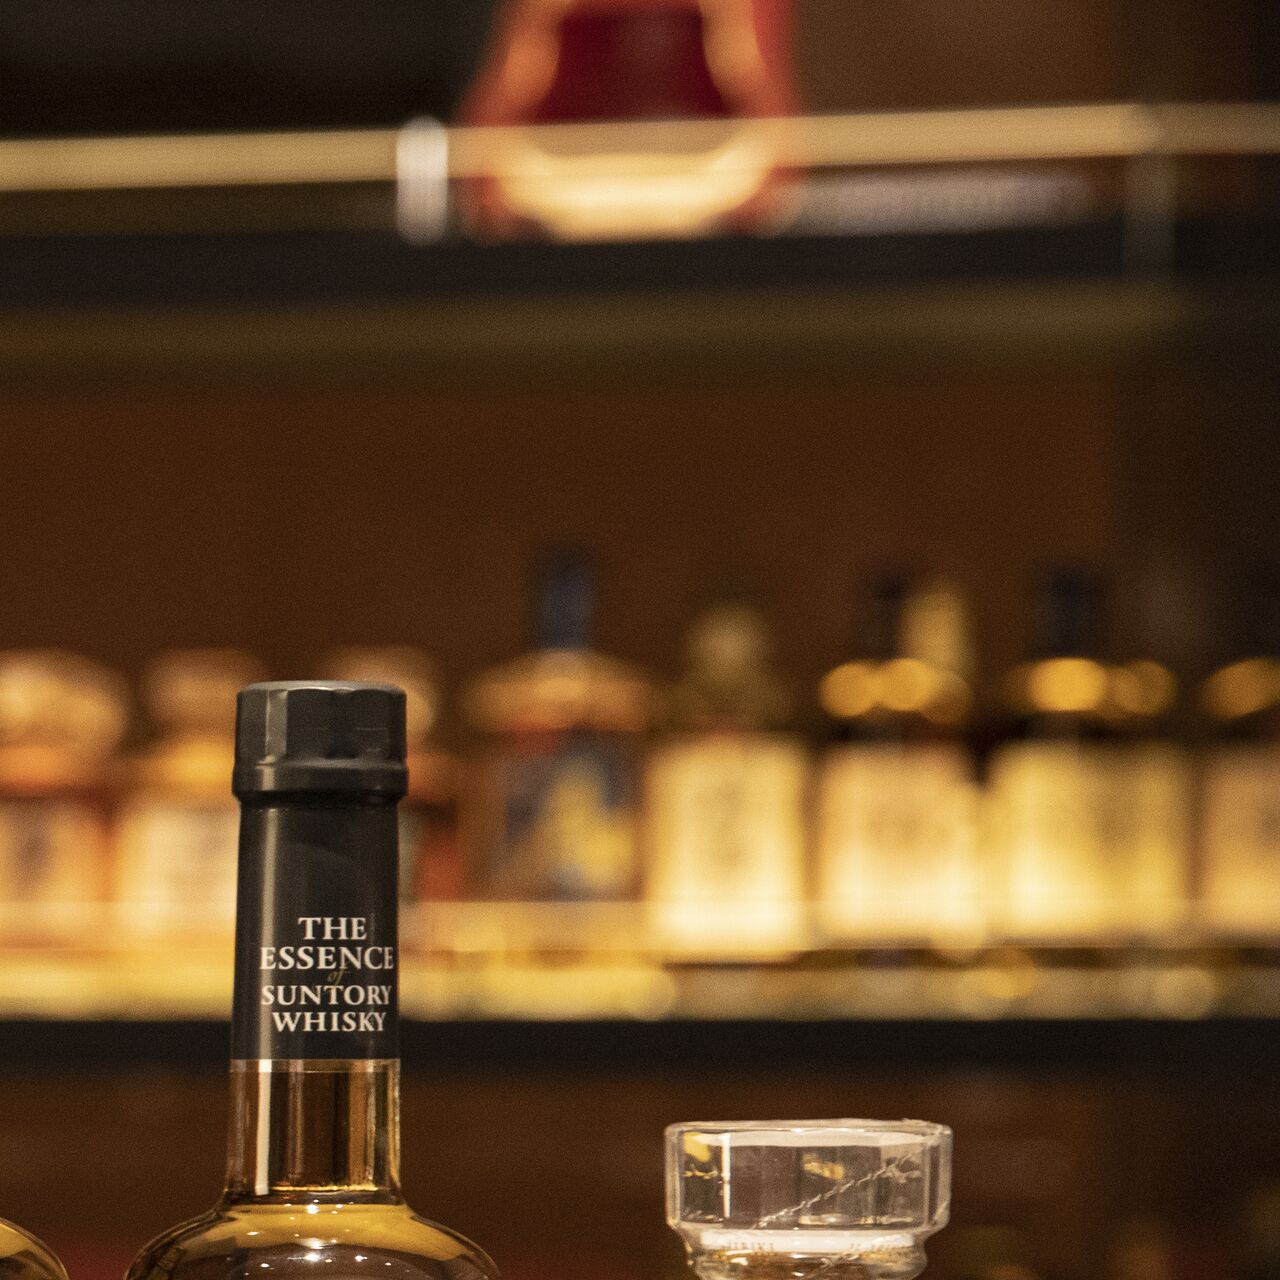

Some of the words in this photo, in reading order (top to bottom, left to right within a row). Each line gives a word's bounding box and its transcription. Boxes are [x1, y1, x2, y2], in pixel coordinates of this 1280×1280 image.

[298, 917, 367, 940] THE
[260, 946, 394, 970] ESSENCE
[262, 985, 392, 1005] SUNTORY
[272, 1012, 386, 1032] WHISKY
